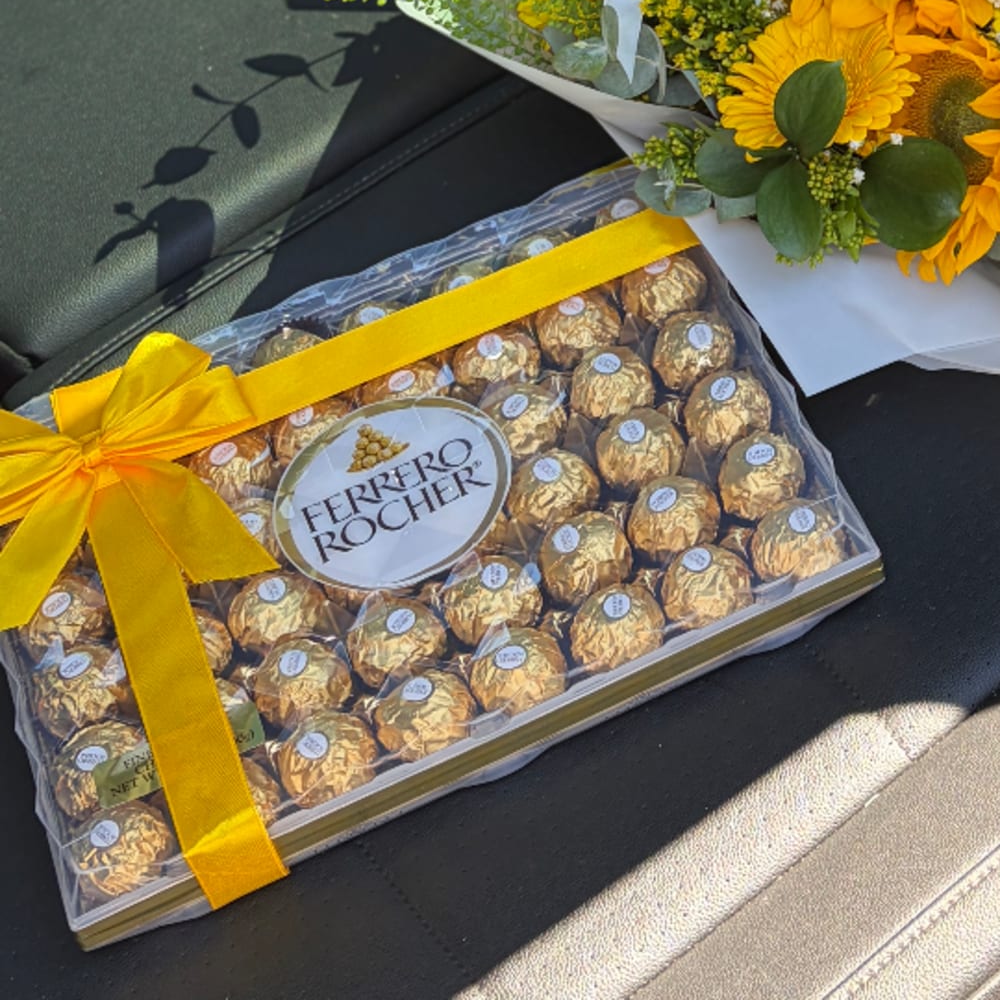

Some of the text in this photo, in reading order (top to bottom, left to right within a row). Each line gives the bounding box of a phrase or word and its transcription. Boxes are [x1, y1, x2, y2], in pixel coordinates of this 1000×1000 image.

[301, 438, 473, 533] FERRERO
[312, 465, 492, 564] ROCHER
[110, 777, 137, 798] NET
